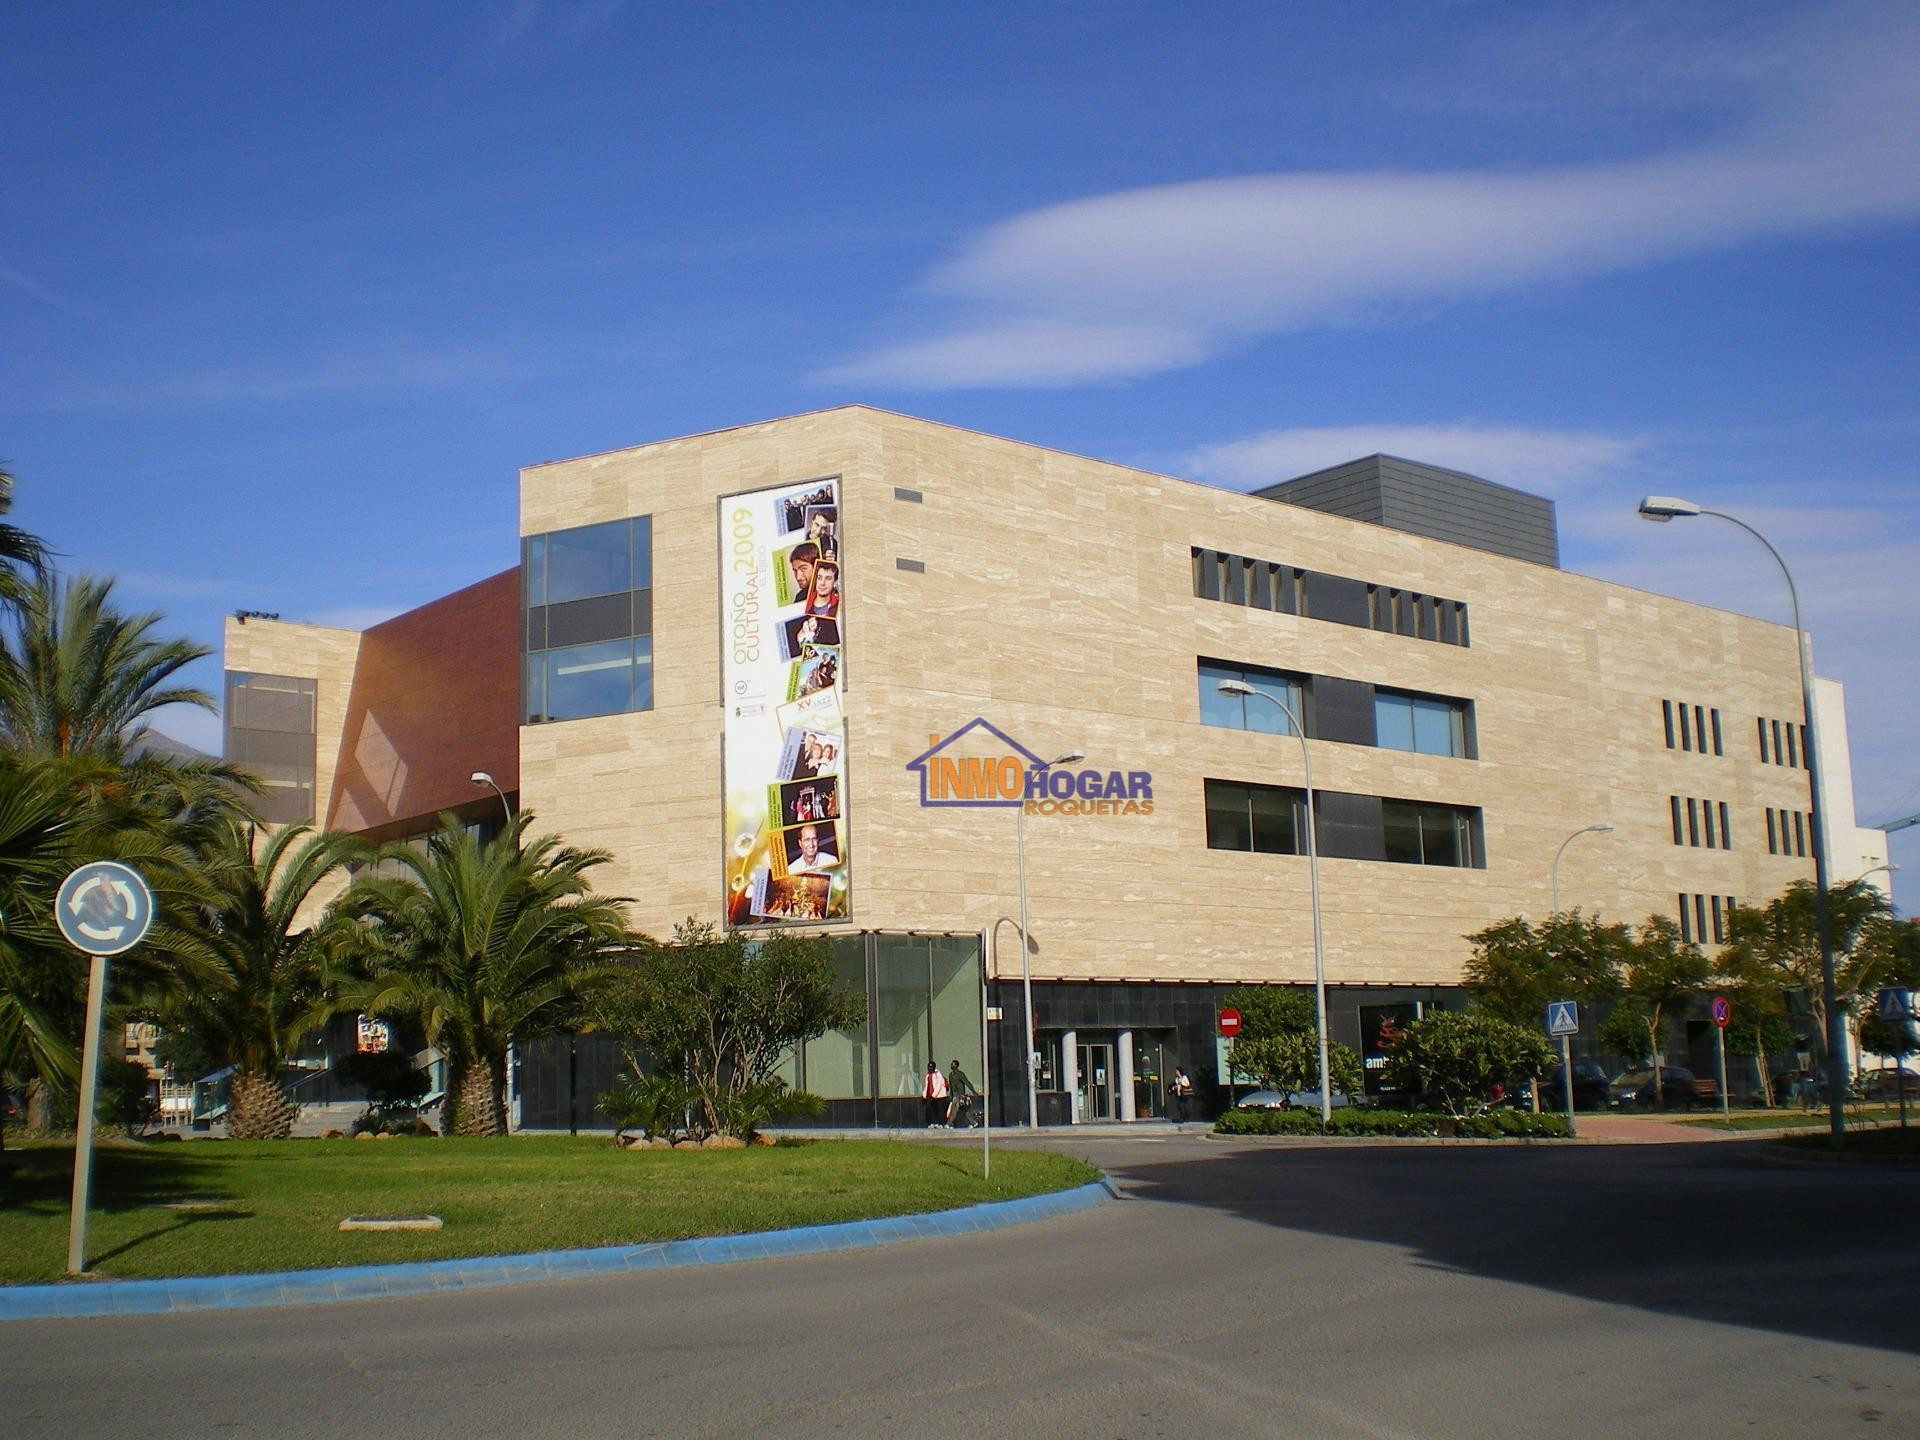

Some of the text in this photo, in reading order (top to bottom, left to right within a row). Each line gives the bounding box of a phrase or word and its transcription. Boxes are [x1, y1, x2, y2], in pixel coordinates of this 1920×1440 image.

[733, 507, 755, 573] 2009
[730, 592, 747, 664] OTOÑO
[745, 565, 760, 662] CULTURAL
